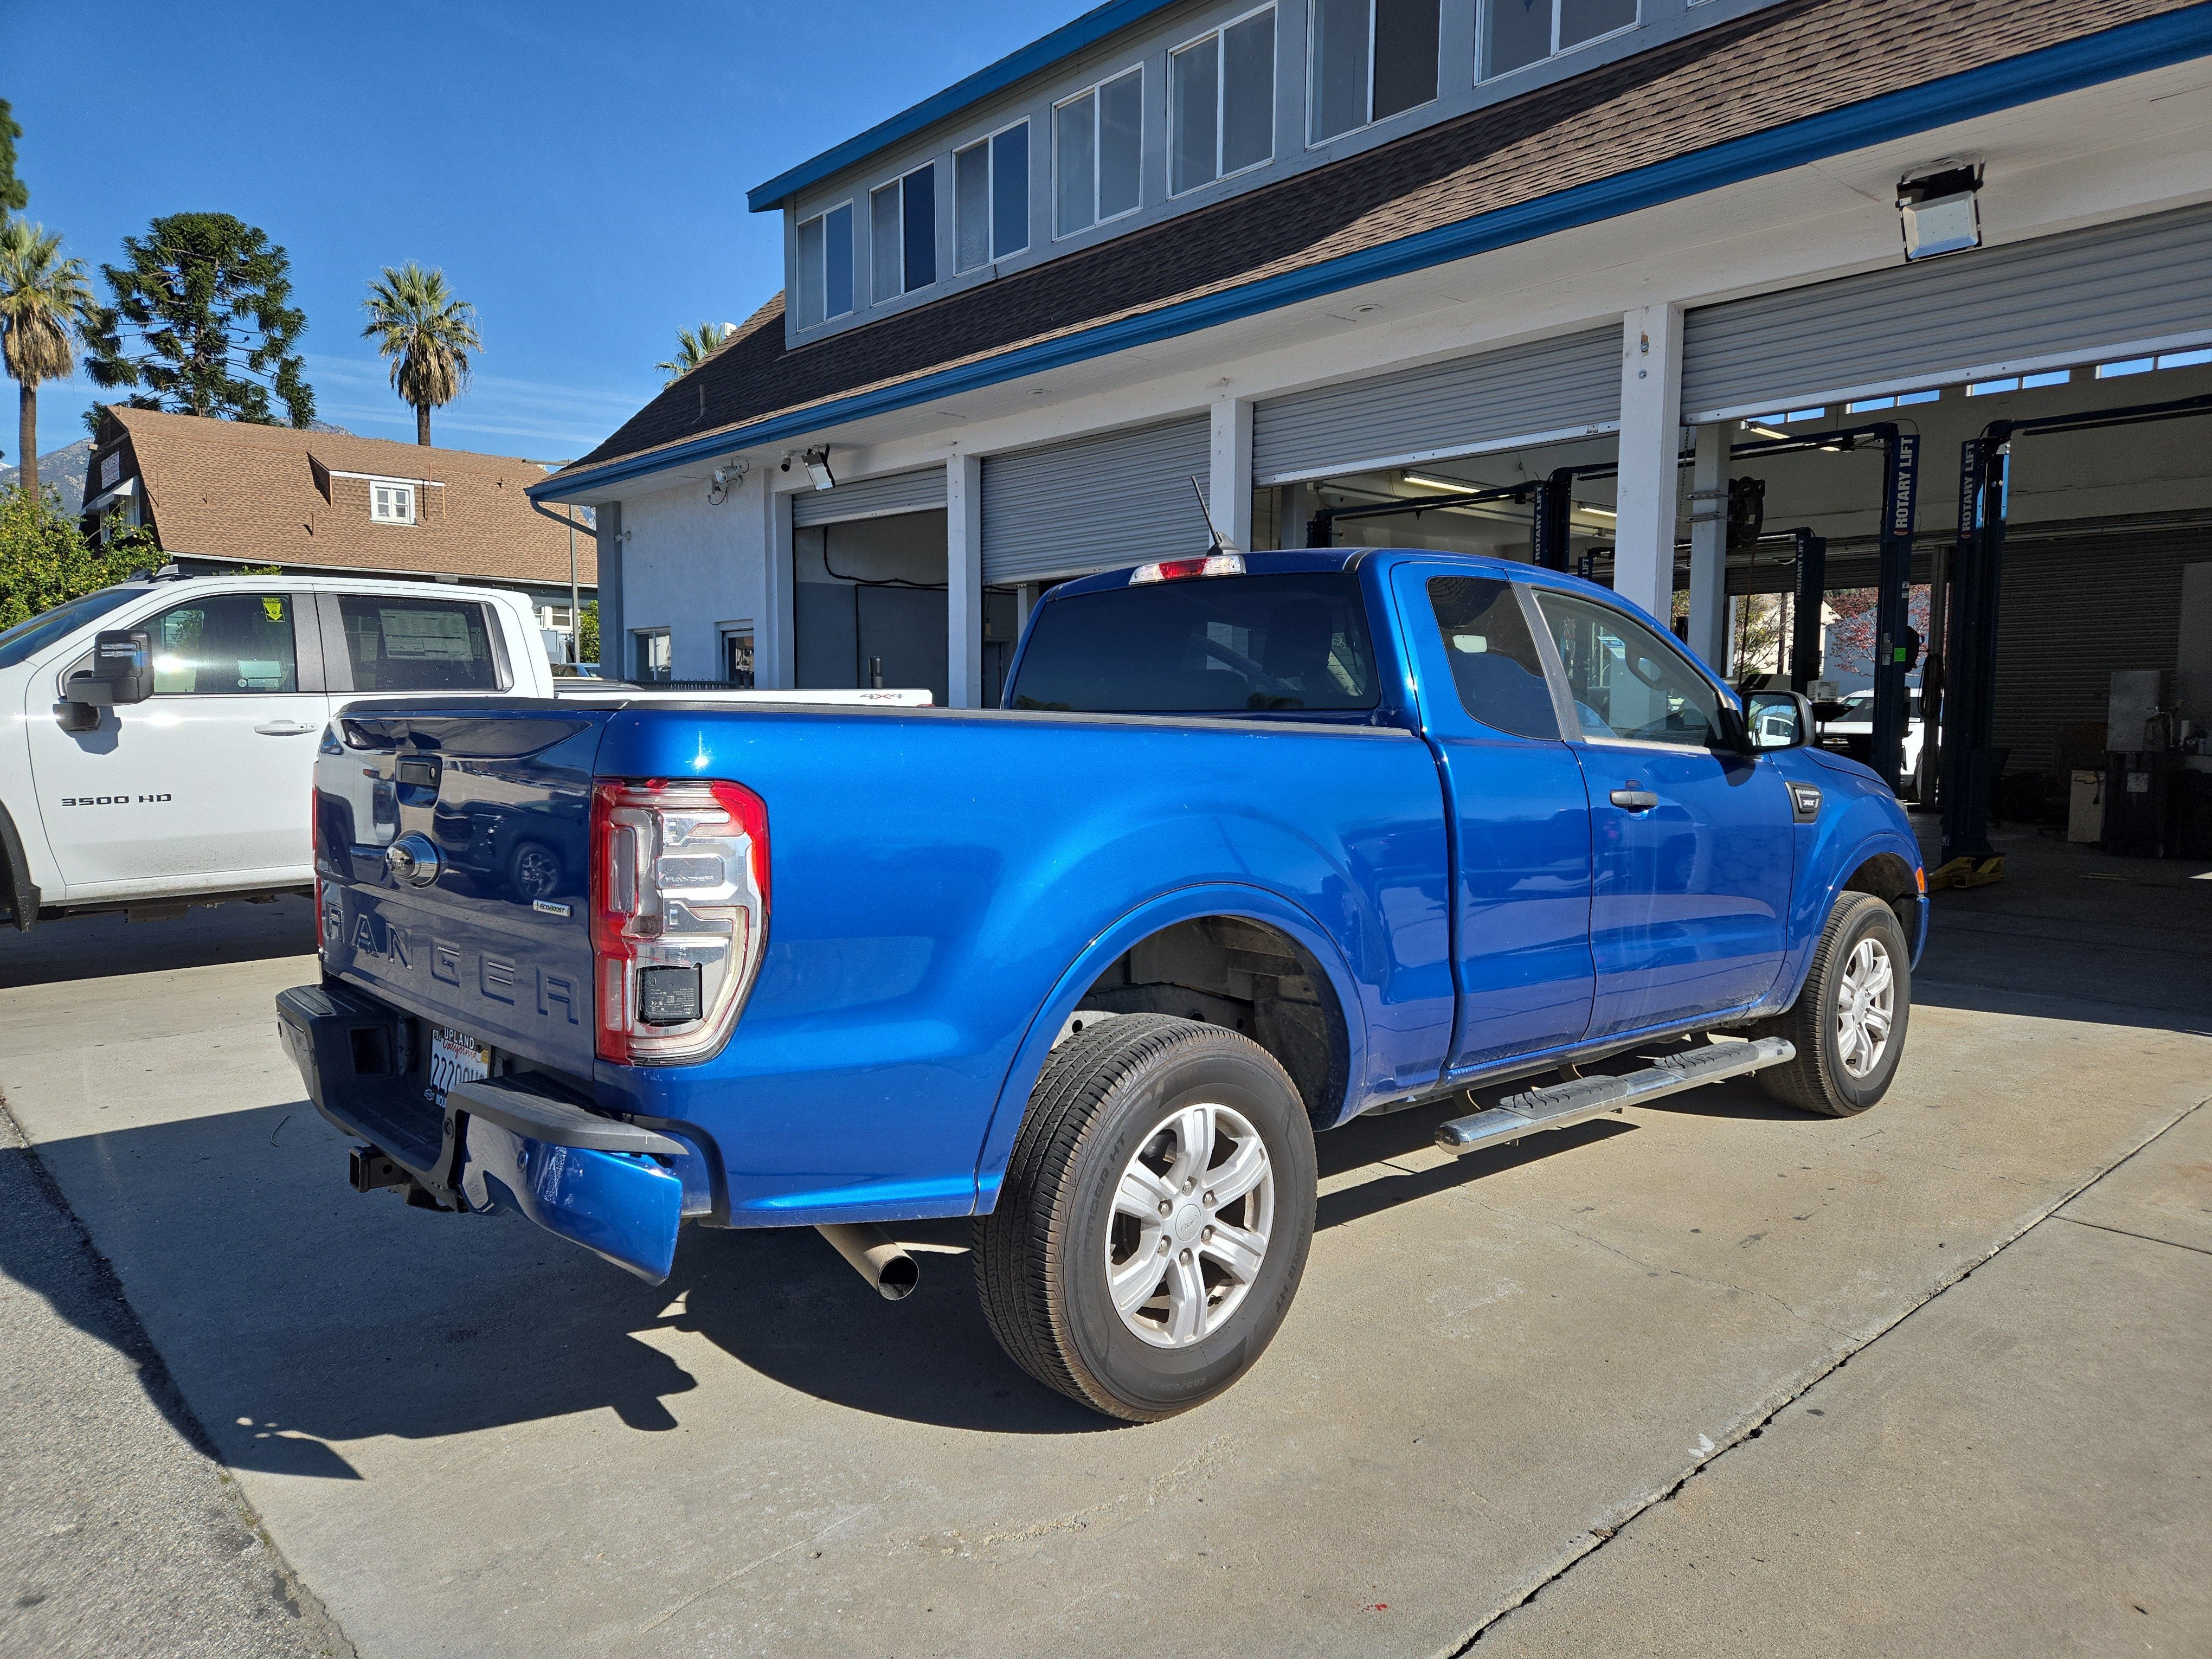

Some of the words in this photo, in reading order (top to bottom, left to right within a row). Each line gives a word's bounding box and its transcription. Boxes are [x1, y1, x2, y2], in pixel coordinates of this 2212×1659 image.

[1899, 438, 1913, 467] LIFT
[1965, 442, 1975, 471] LIFT
[1895, 471, 1911, 528] ROTARY
[1962, 476, 1973, 531] ROTARY
[62, 796, 129, 807] 3500
[138, 794, 172, 803] HD
[326, 900, 580, 1025] RANGER
[442, 1039, 482, 1063] California
[443, 1027, 475, 1050] UPLAND
[432, 1053, 485, 1094] 2220
[1109, 1131, 1125, 1163] HT
